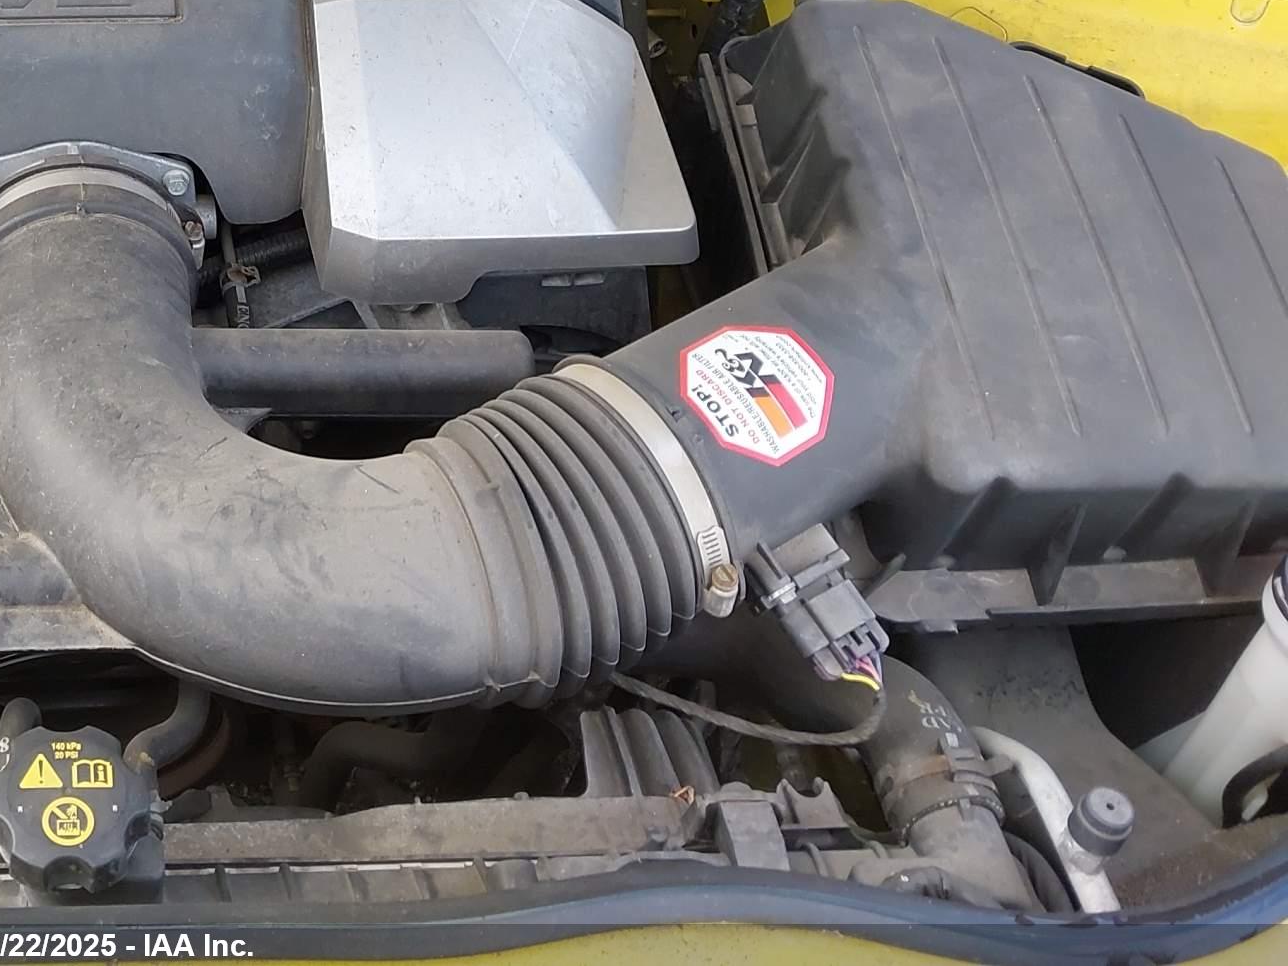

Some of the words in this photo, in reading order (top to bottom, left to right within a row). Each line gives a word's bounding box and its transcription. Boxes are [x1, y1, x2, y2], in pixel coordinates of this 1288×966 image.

[711, 367, 725, 380] AIR
[695, 369, 733, 405] DISCARD
[691, 384, 740, 437] STOP!
[729, 405, 750, 427] NOT
[745, 428, 761, 444] DO
[51, 742, 65, 751] 140
[67, 742, 82, 751] kPa
[54, 751, 64, 760] 20
[65, 751, 79, 759] PSI
